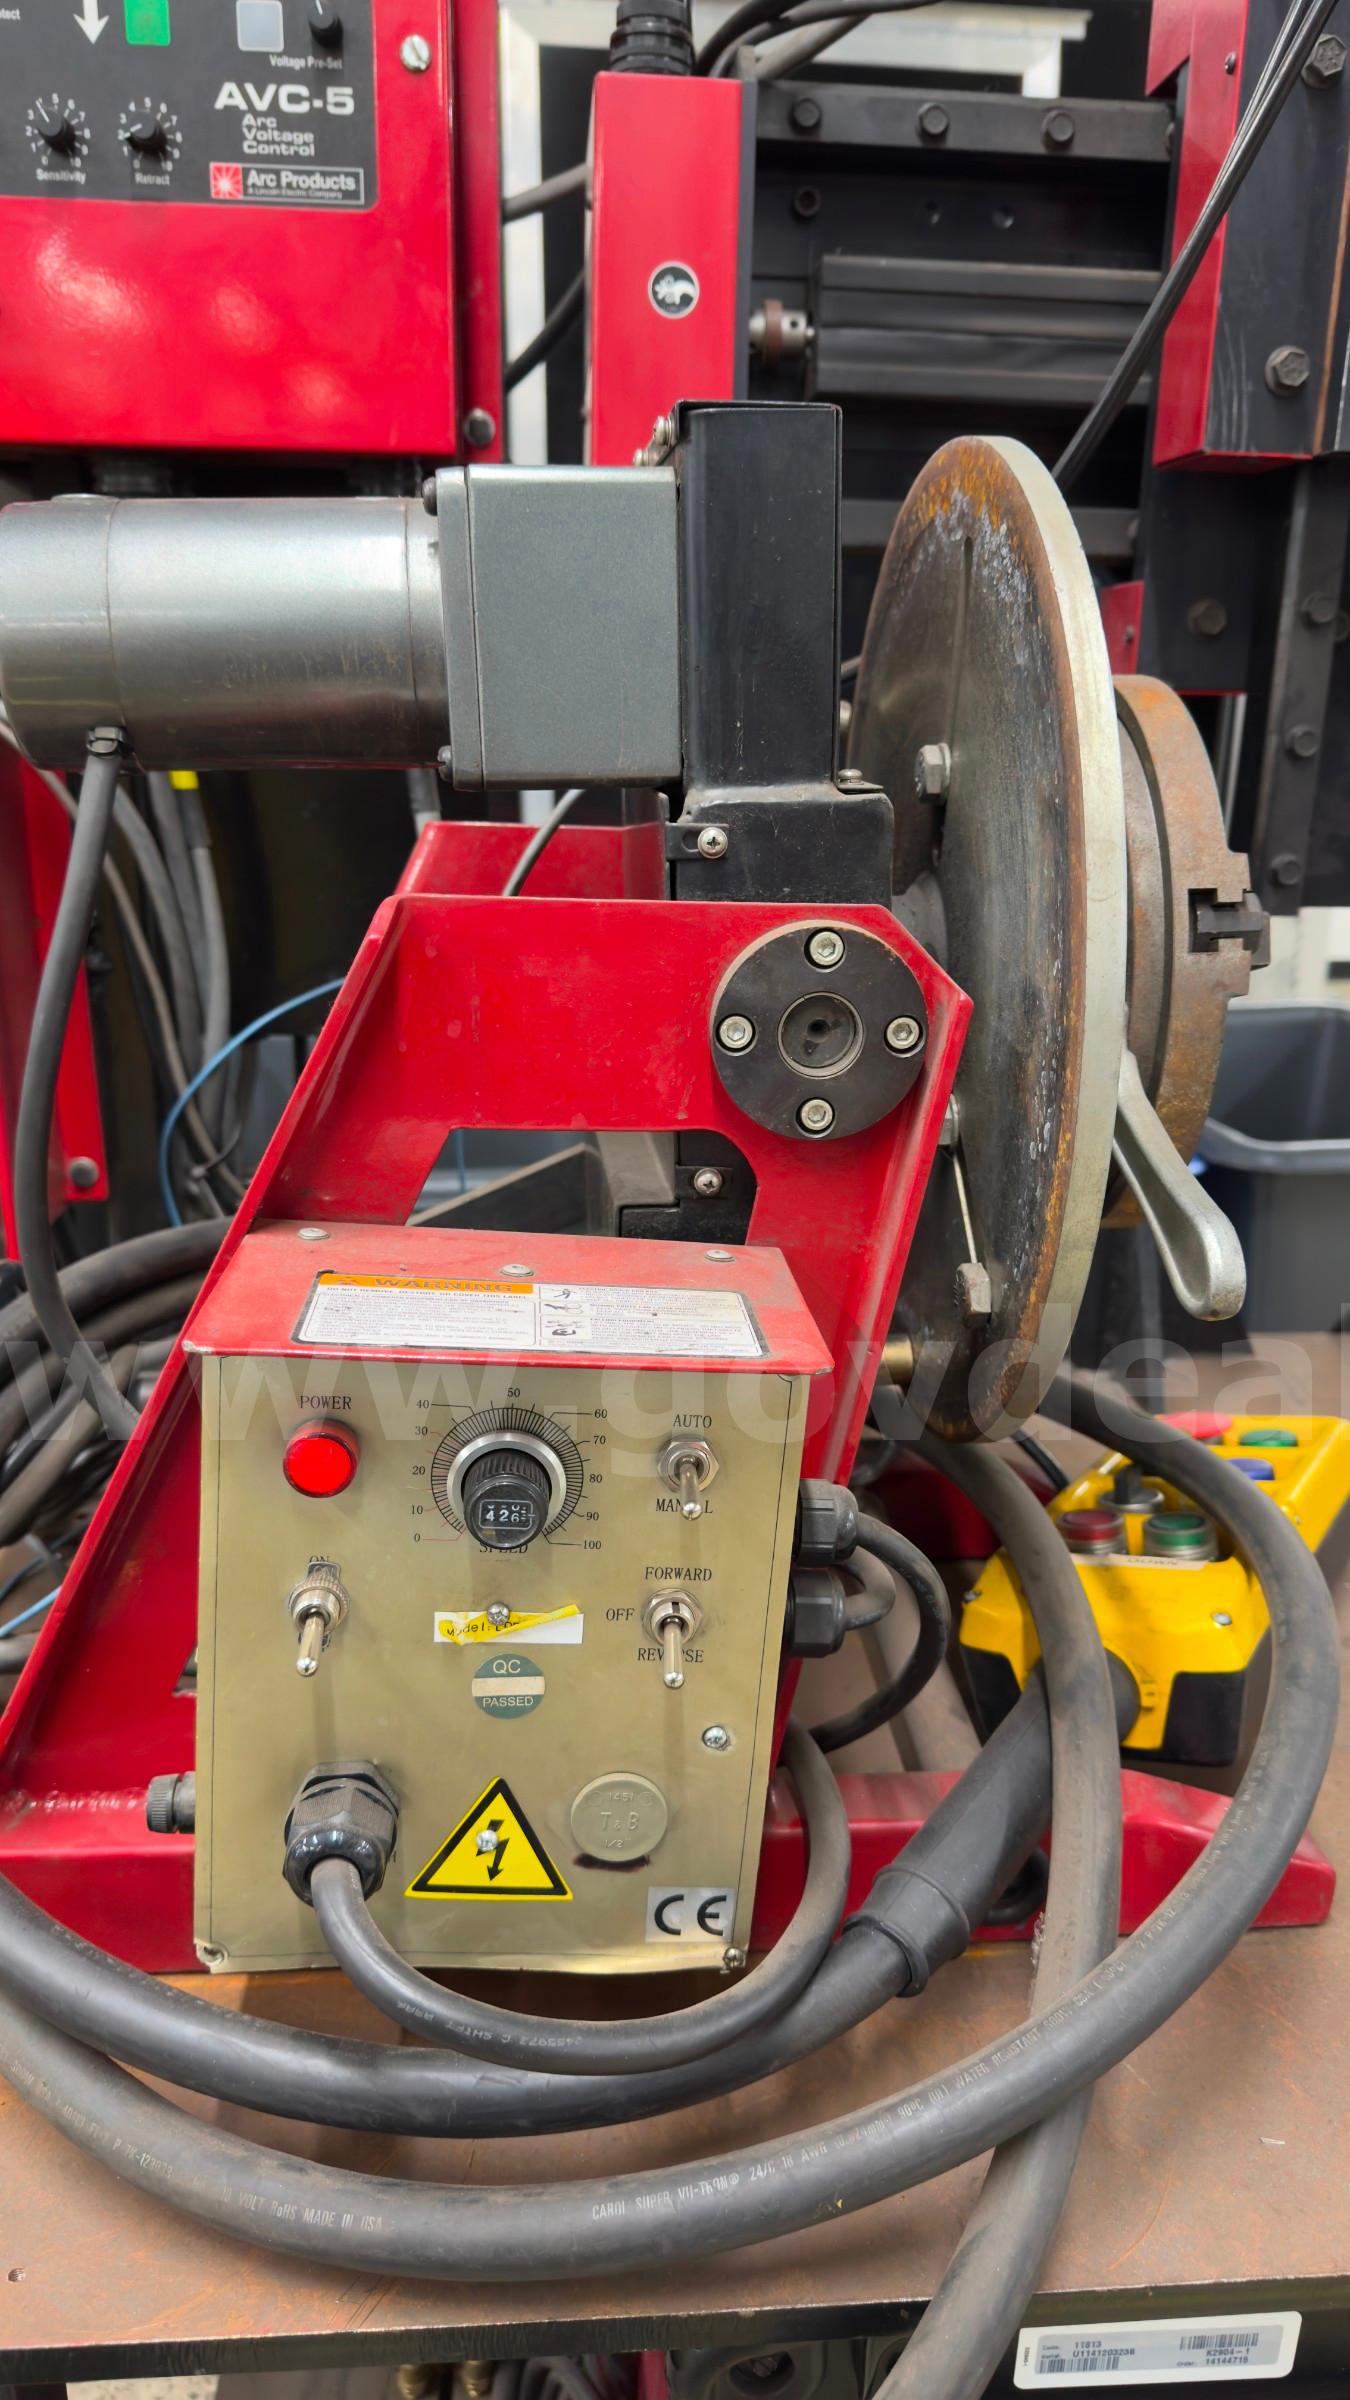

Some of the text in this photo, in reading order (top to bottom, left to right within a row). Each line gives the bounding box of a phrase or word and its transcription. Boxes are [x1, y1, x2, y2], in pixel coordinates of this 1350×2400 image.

[269, 54, 306, 71] Voltage
[214, 81, 355, 115] AVC-5
[242, 113, 278, 128] Arc
[242, 127, 315, 145] Voltage
[242, 141, 315, 157] Control
[36, 168, 86, 184] Sensitivity
[134, 171, 170, 186] Retract
[247, 169, 356, 191] Arc Products
[375, 1278, 513, 1292] WARNING
[507, 1388, 520, 1398] 50
[300, 1395, 352, 1410] POWER
[416, 1400, 429, 1409] 40
[594, 1409, 608, 1419] 60
[673, 1414, 712, 1428] AUTO
[415, 1426, 428, 1436] 30
[593, 1435, 606, 1445] 70
[412, 1465, 426, 1475] 20
[589, 1474, 603, 1483] 80
[410, 1505, 423, 1515] 10
[655, 1498, 713, 1514] MANL
[586, 1511, 599, 1521] 90
[414, 1533, 421, 1542] 0
[583, 1540, 602, 1549] 100
[645, 1566, 712, 1582] FORWARD
[606, 1608, 635, 1621] OFF
[637, 1647, 705, 1663] REVSE
[492, 1659, 521, 1674] QC
[482, 1696, 534, 1707] PASSED
[303, 2207, 336, 2228] MADE
[341, 2213, 354, 2229] IN
[360, 2215, 383, 2233] USA
